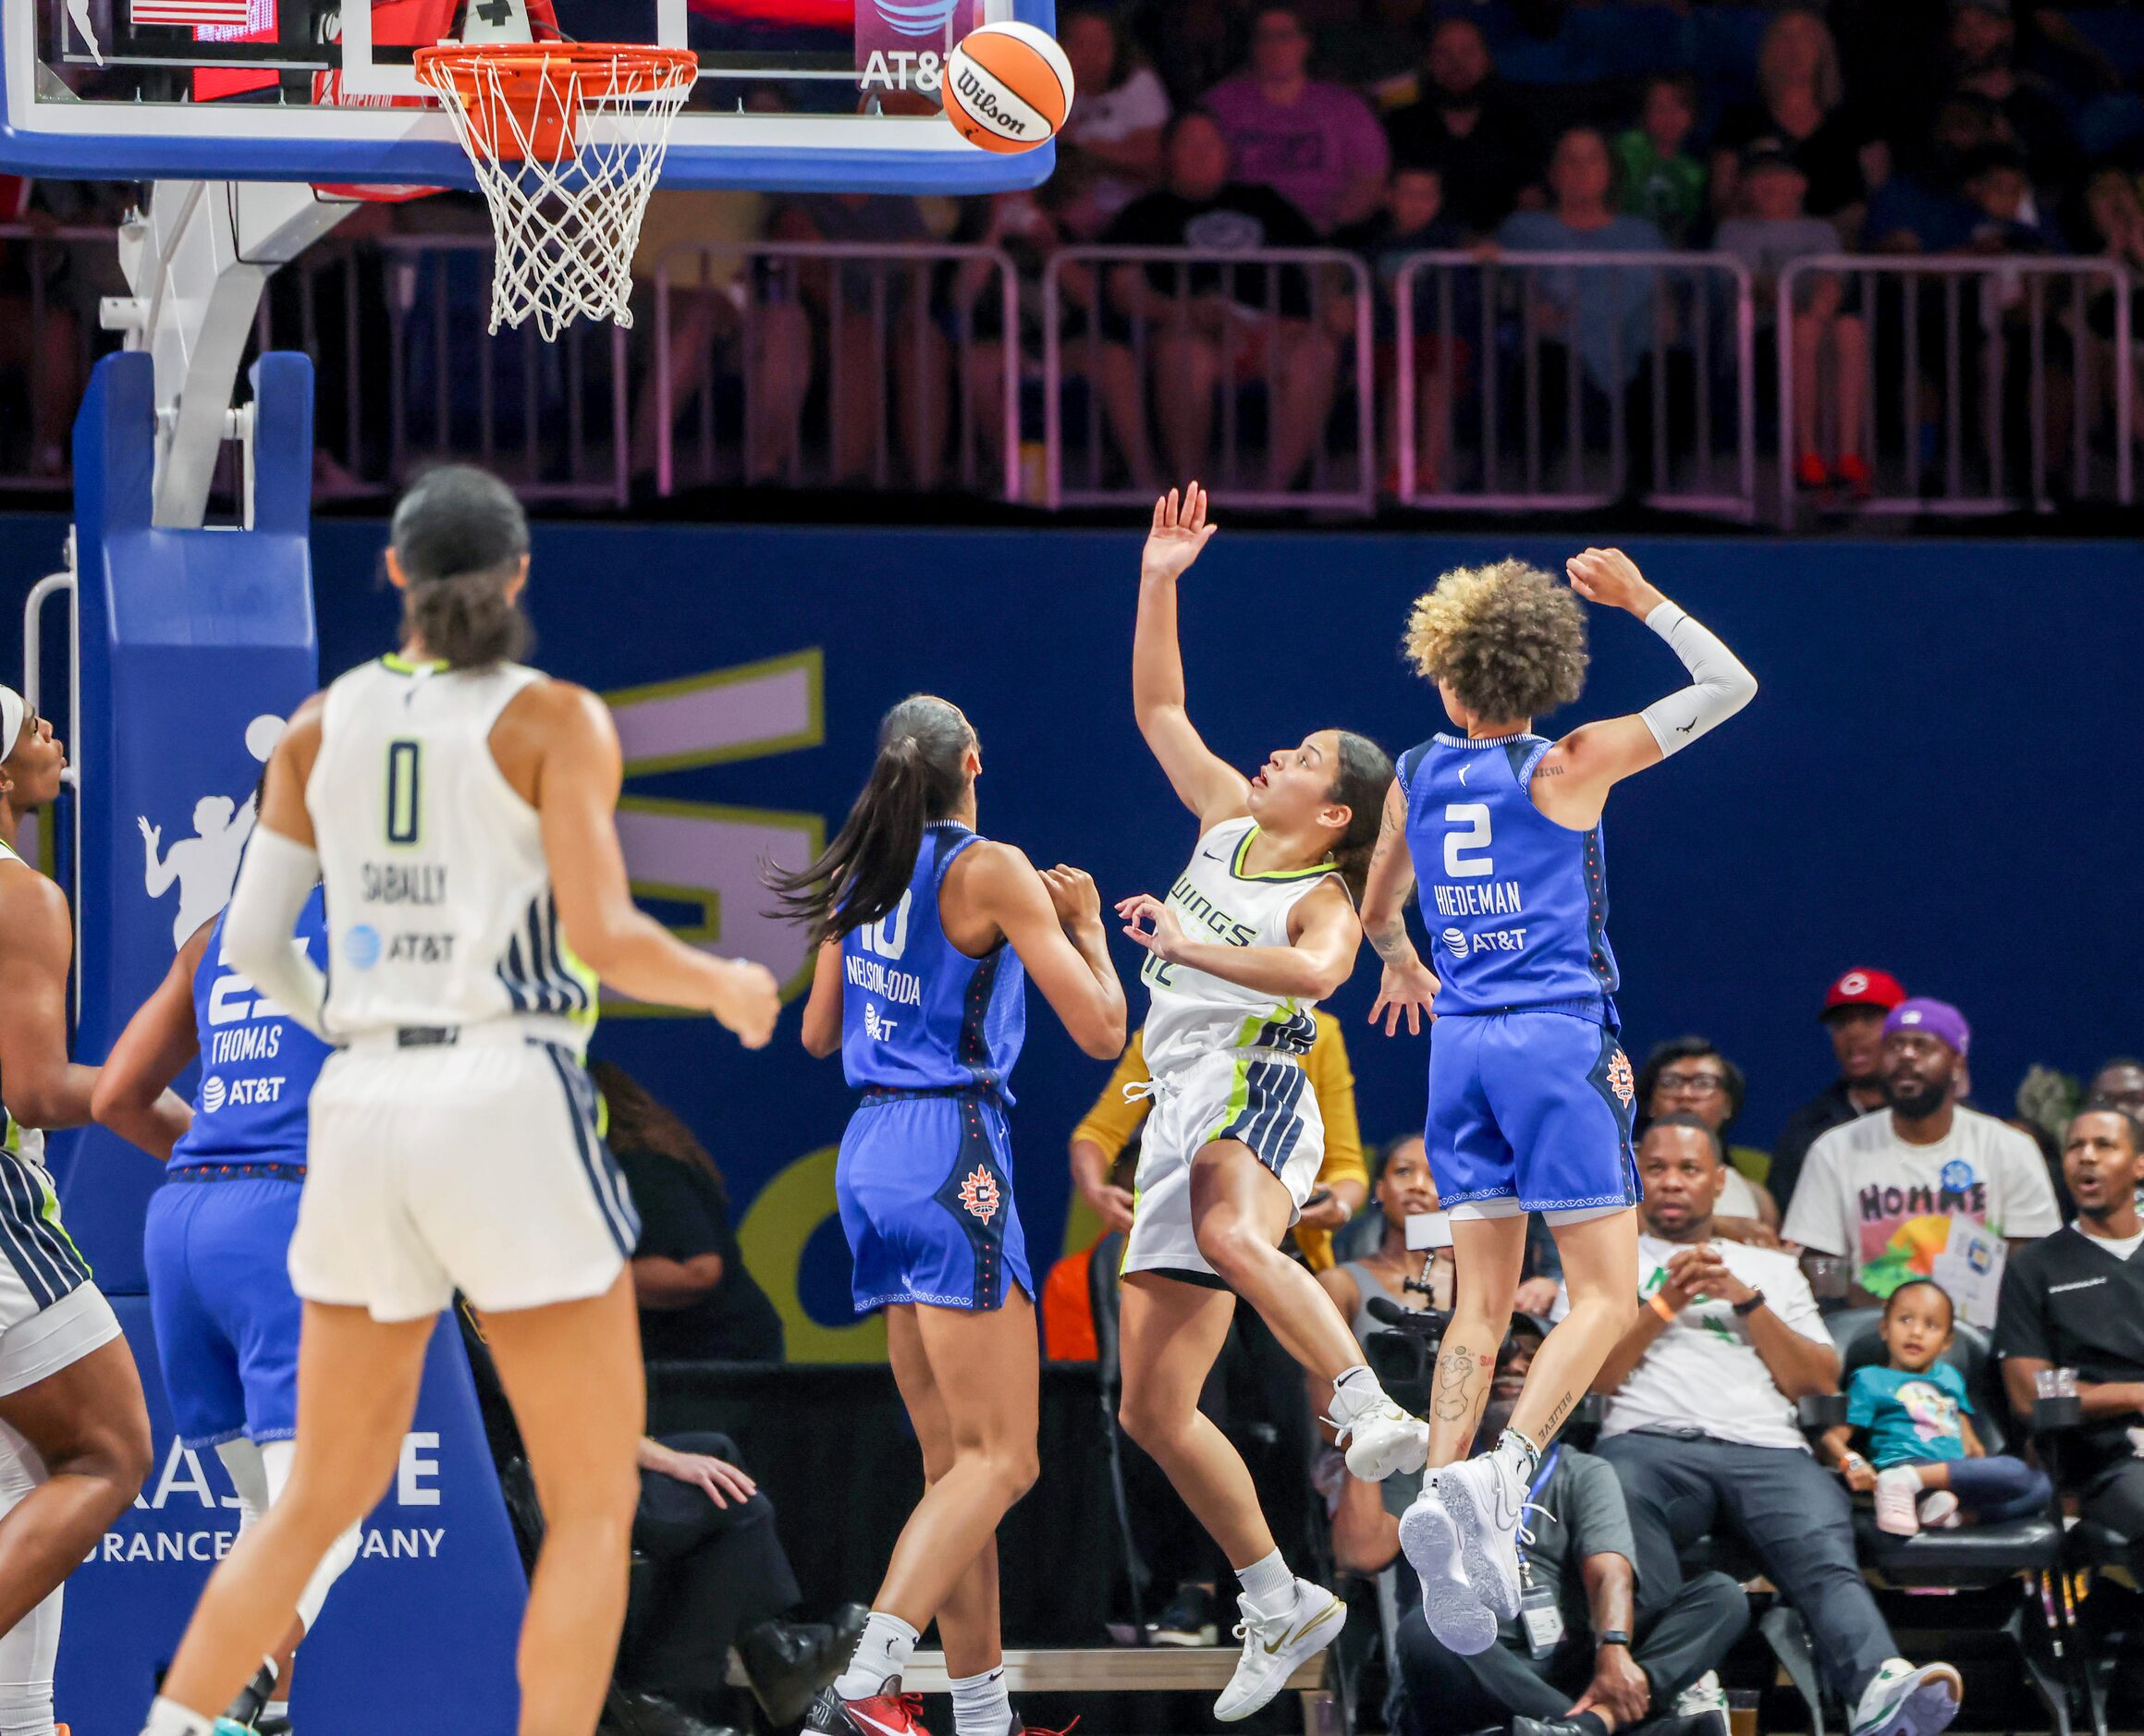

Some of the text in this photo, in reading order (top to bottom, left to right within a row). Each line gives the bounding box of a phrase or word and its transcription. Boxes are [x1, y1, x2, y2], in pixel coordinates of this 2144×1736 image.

[860, 49, 948, 92] AT&
[957, 66, 1026, 136] Wilson
[386, 739, 420, 845] 0
[1443, 802, 1494, 878] 2
[1434, 881, 1522, 917] HIEDEMAN
[387, 932, 455, 963] AT&T
[1473, 928, 1527, 954] AT&T
[211, 1025, 283, 1065] THOMAS
[228, 1076, 286, 1106] AT&T
[1538, 1389, 1574, 1443] BELIEVE
